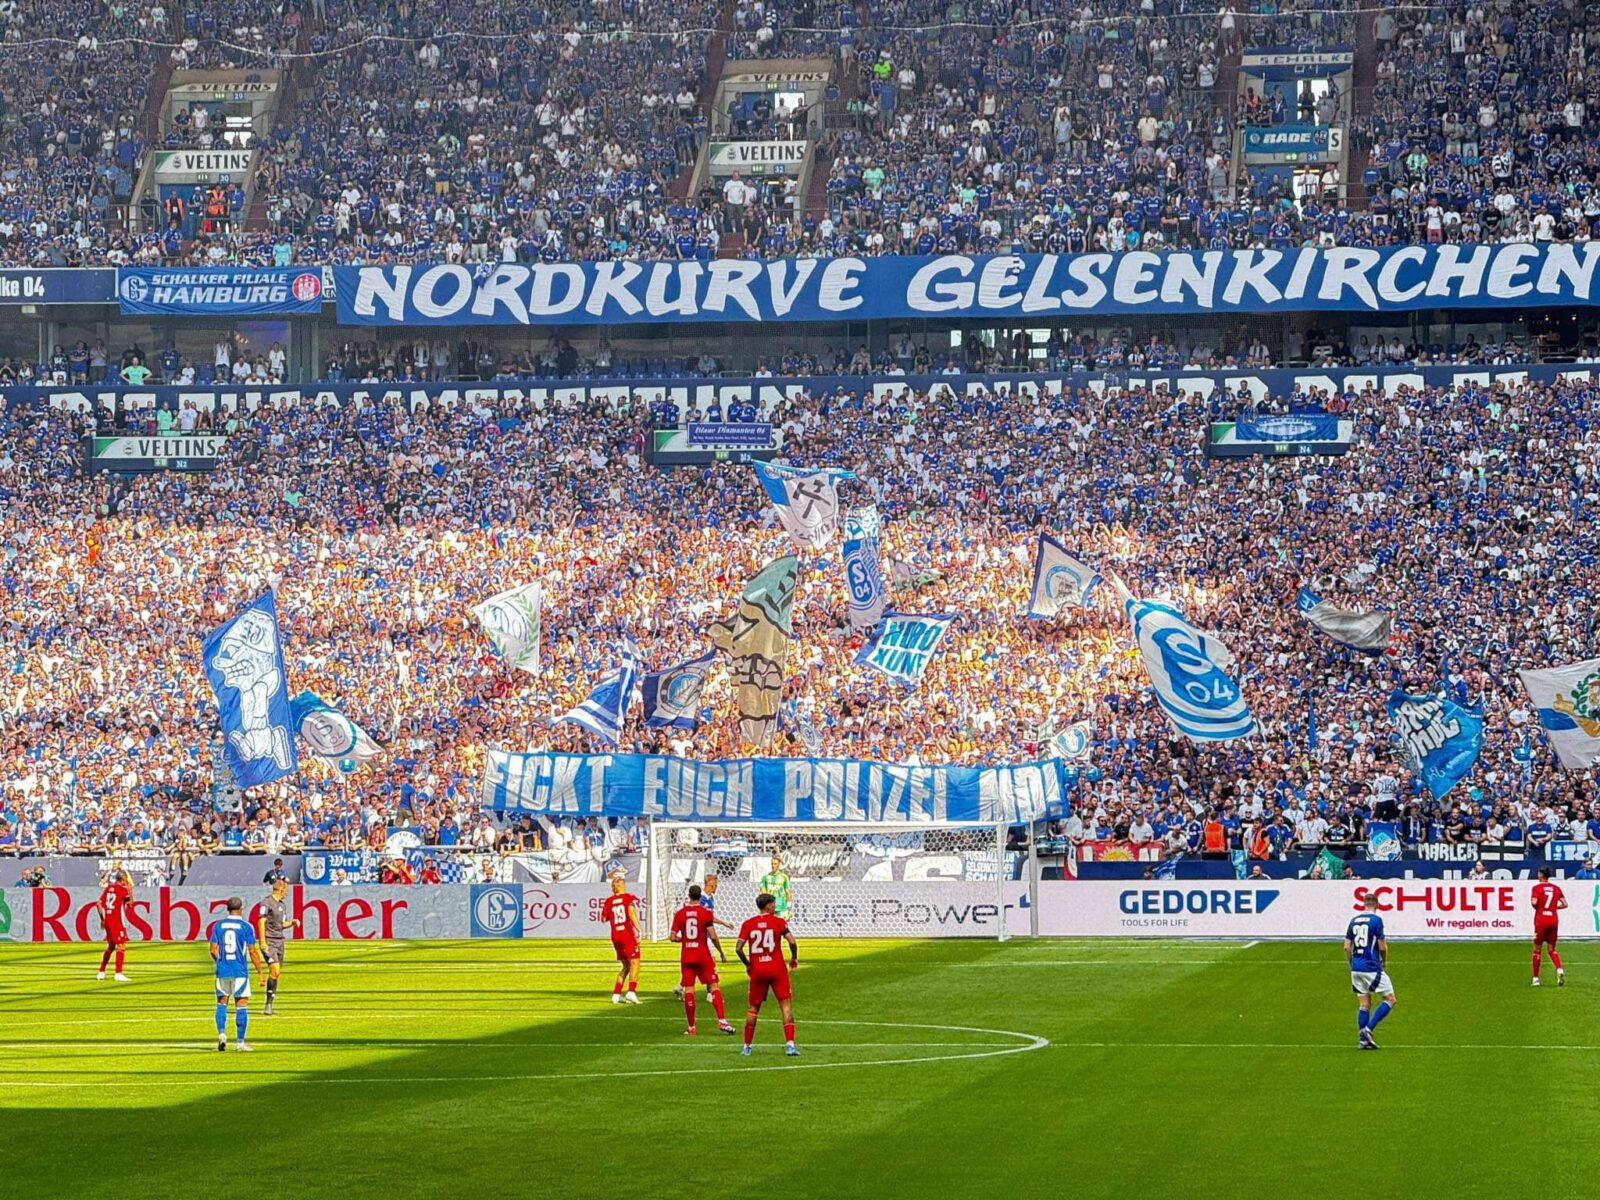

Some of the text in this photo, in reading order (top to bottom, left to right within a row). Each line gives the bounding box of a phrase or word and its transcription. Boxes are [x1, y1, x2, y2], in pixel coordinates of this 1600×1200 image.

[201, 83, 271, 91] VELTINS
[185, 154, 249, 169] VELTINS
[740, 145, 804, 161] VELTINS
[23, 276, 45, 297] 04
[152, 273, 288, 285] SCHALKER FILIALE
[906, 240, 1600, 312] GELSENKIRCHEN
[152, 285, 287, 304] HAMBURG
[353, 258, 867, 324] NORDKURVE
[139, 439, 216, 457] VELTINS
[1185, 678, 1235, 703] 04
[482, 753, 613, 813] FICKT
[641, 757, 753, 817] EUCH
[784, 760, 947, 821] POLIZEI
[1119, 890, 1252, 914] GEDORE
[1353, 887, 1514, 911] SCHULTE
[1544, 892, 1554, 909] 7
[612, 904, 627, 925] 19
[1121, 919, 1189, 927] TOOLS FOR LIFE
[1426, 918, 1514, 930] Wir regalen das.
[686, 917, 698, 940] 6
[1352, 924, 1369, 947] 29
[224, 929, 237, 953] 9
[750, 929, 776, 954] 24
